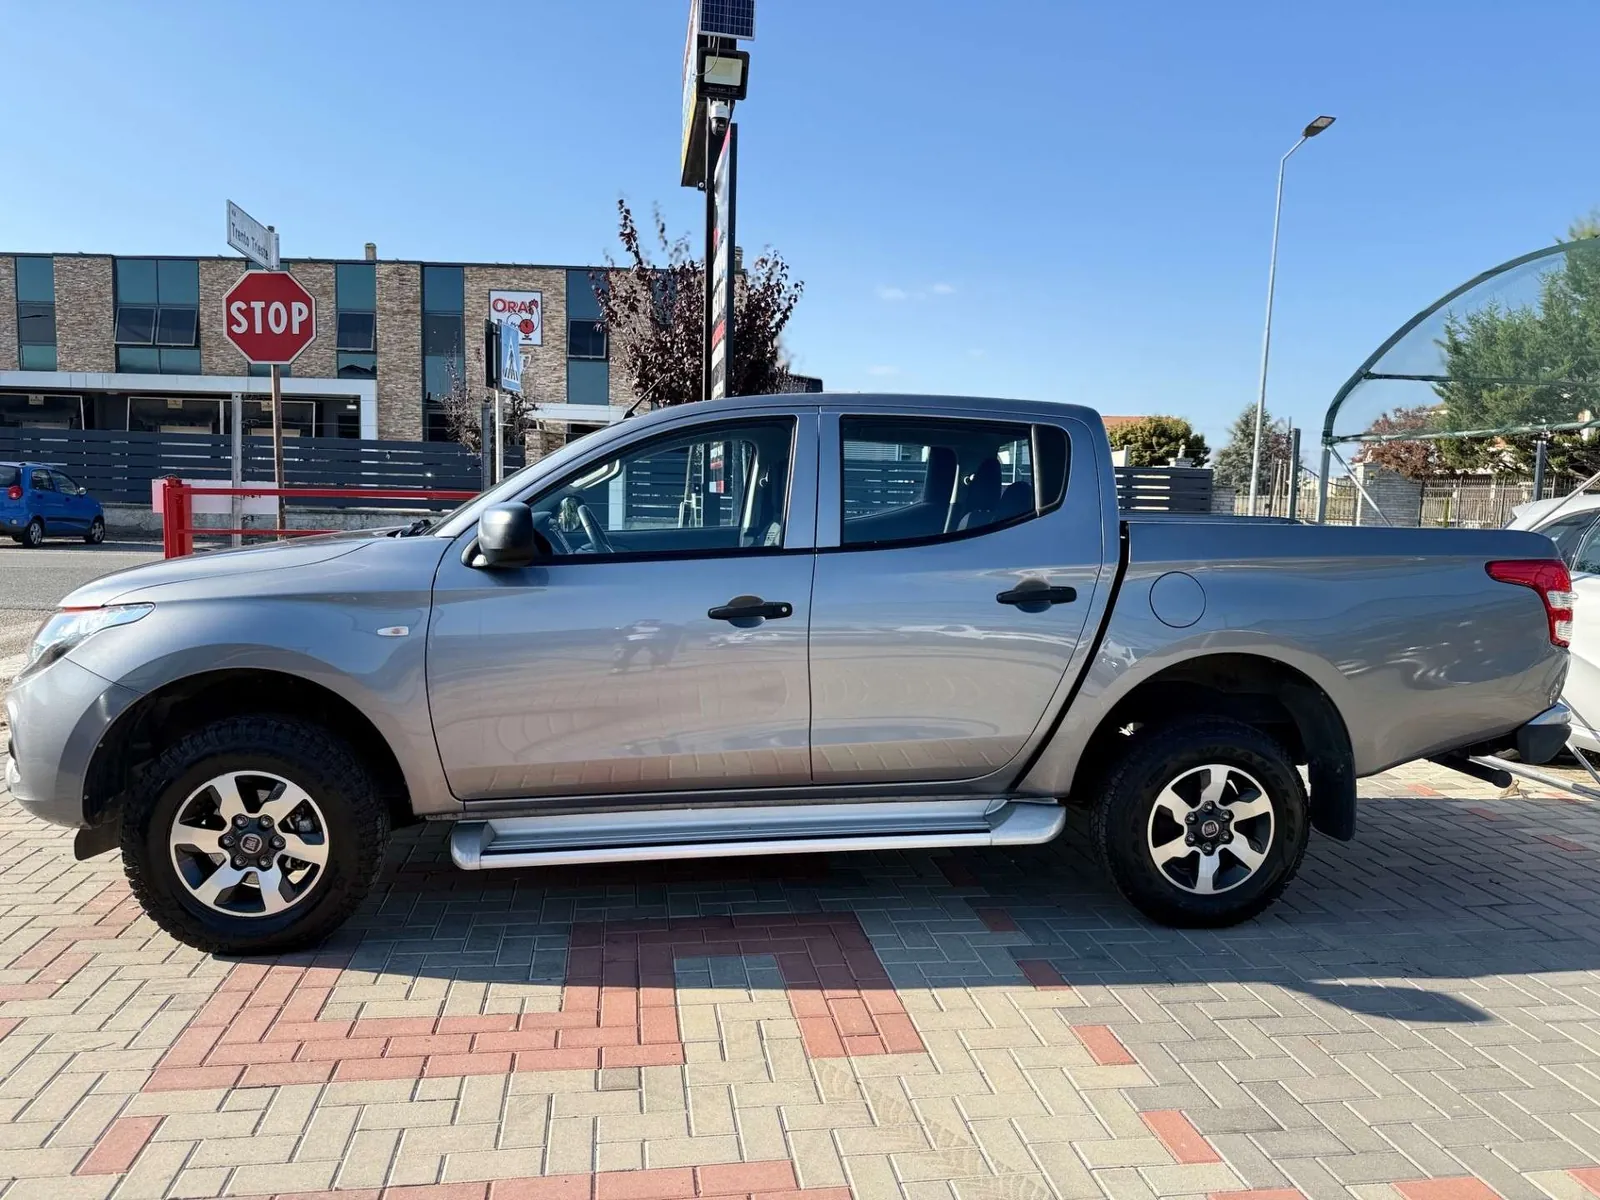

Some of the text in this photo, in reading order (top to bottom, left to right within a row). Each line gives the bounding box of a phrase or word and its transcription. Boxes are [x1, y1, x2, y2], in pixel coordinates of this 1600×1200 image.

[231, 221, 269, 261] Trento Trieste
[230, 300, 309, 335] STOP
